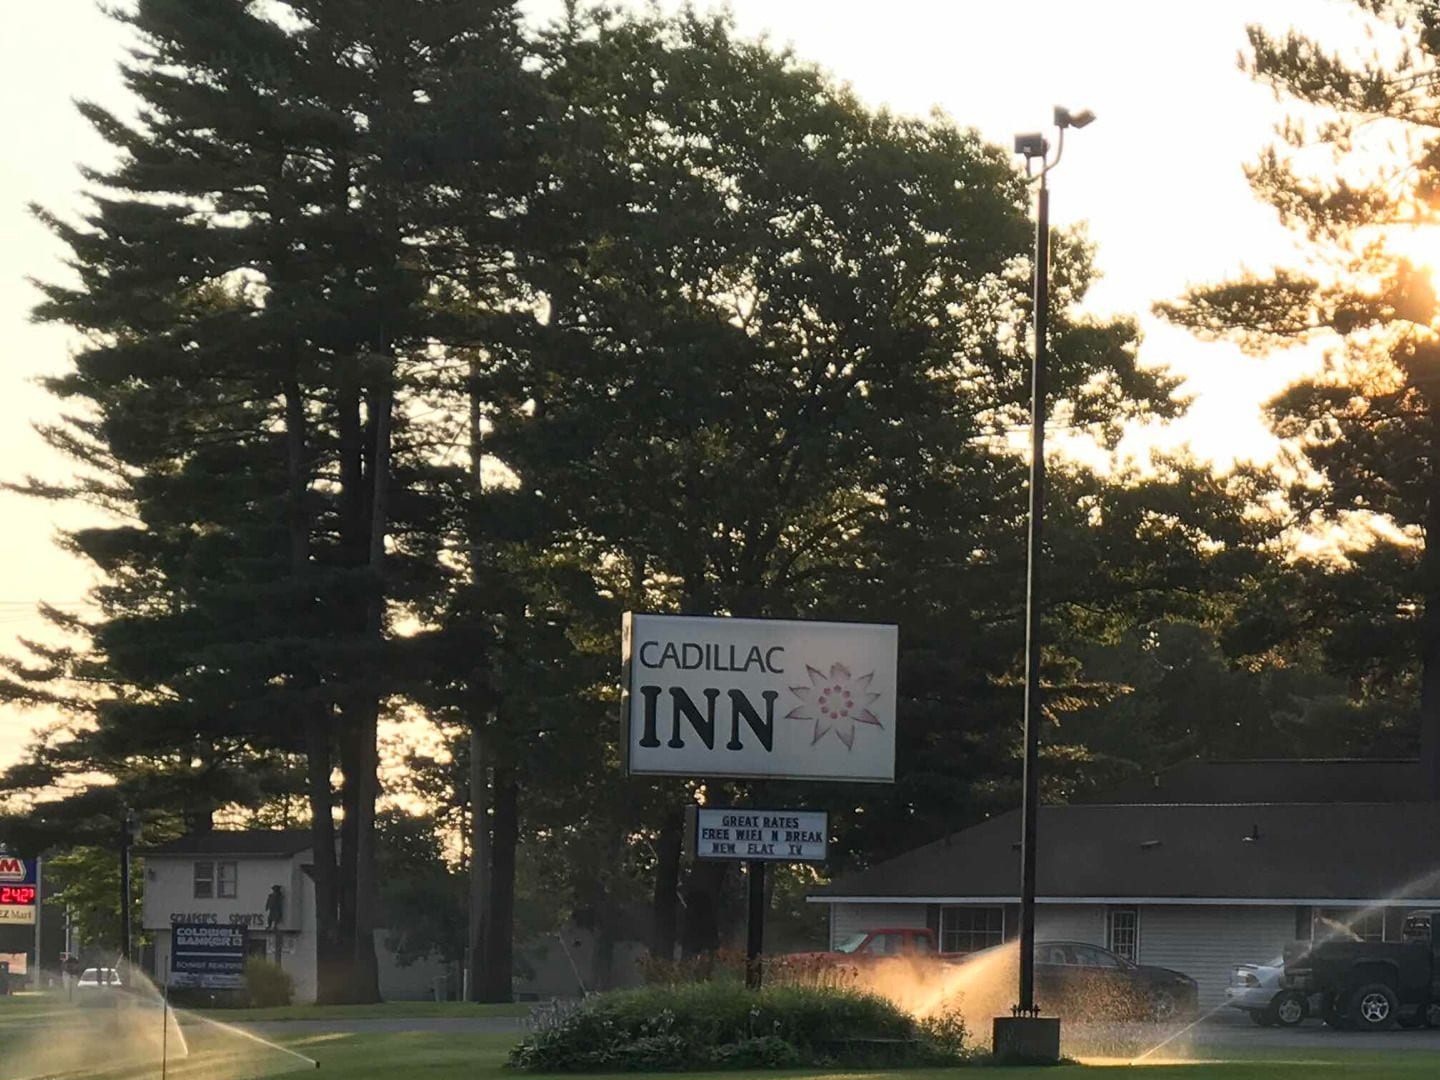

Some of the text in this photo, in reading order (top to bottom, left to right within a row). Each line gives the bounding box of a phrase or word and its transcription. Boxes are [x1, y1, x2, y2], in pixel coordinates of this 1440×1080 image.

[639, 640, 785, 674] CADILLAC
[638, 685, 779, 753] INN
[722, 815, 799, 828] GREAT RATES
[702, 828, 729, 840] FREE
[736, 829, 762, 842] WIFI
[784, 831, 823, 843] BREAK
[747, 843, 775, 855] FLAT
[788, 844, 803, 856] TV
[11, 910, 32, 920] Mart
[176, 927, 243, 937] COLDWELL
[176, 936, 231, 946] BANKER
